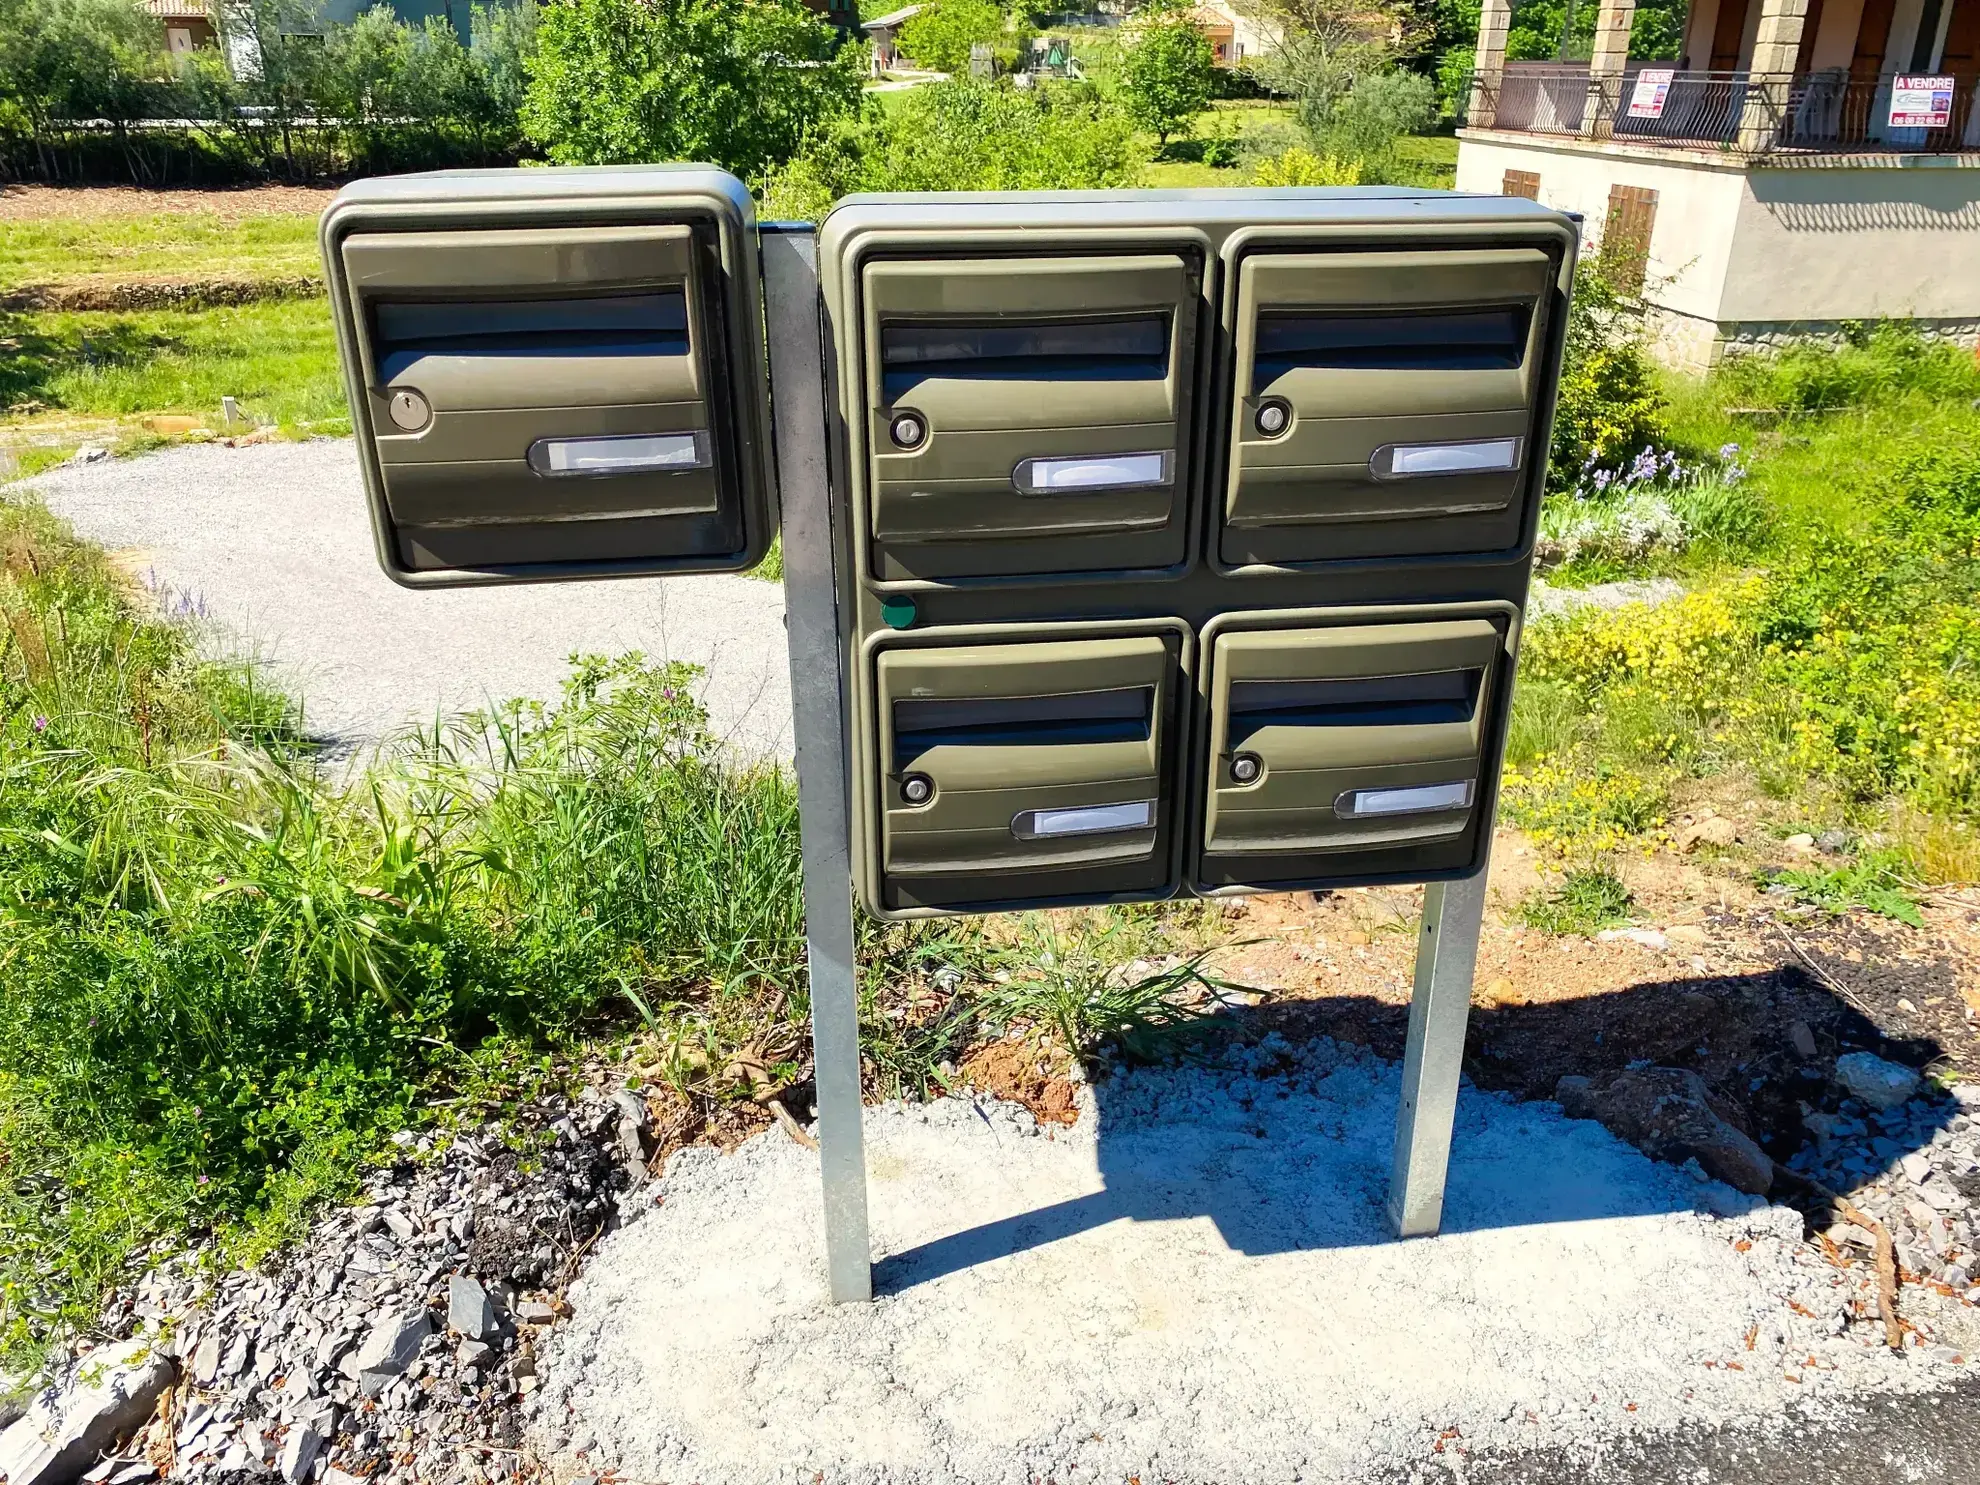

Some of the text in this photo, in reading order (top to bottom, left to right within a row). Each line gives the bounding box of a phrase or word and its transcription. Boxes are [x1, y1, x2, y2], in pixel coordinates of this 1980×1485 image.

[1646, 71, 1672, 83] VENDRE
[1896, 77, 1952, 89] A VENDRE
